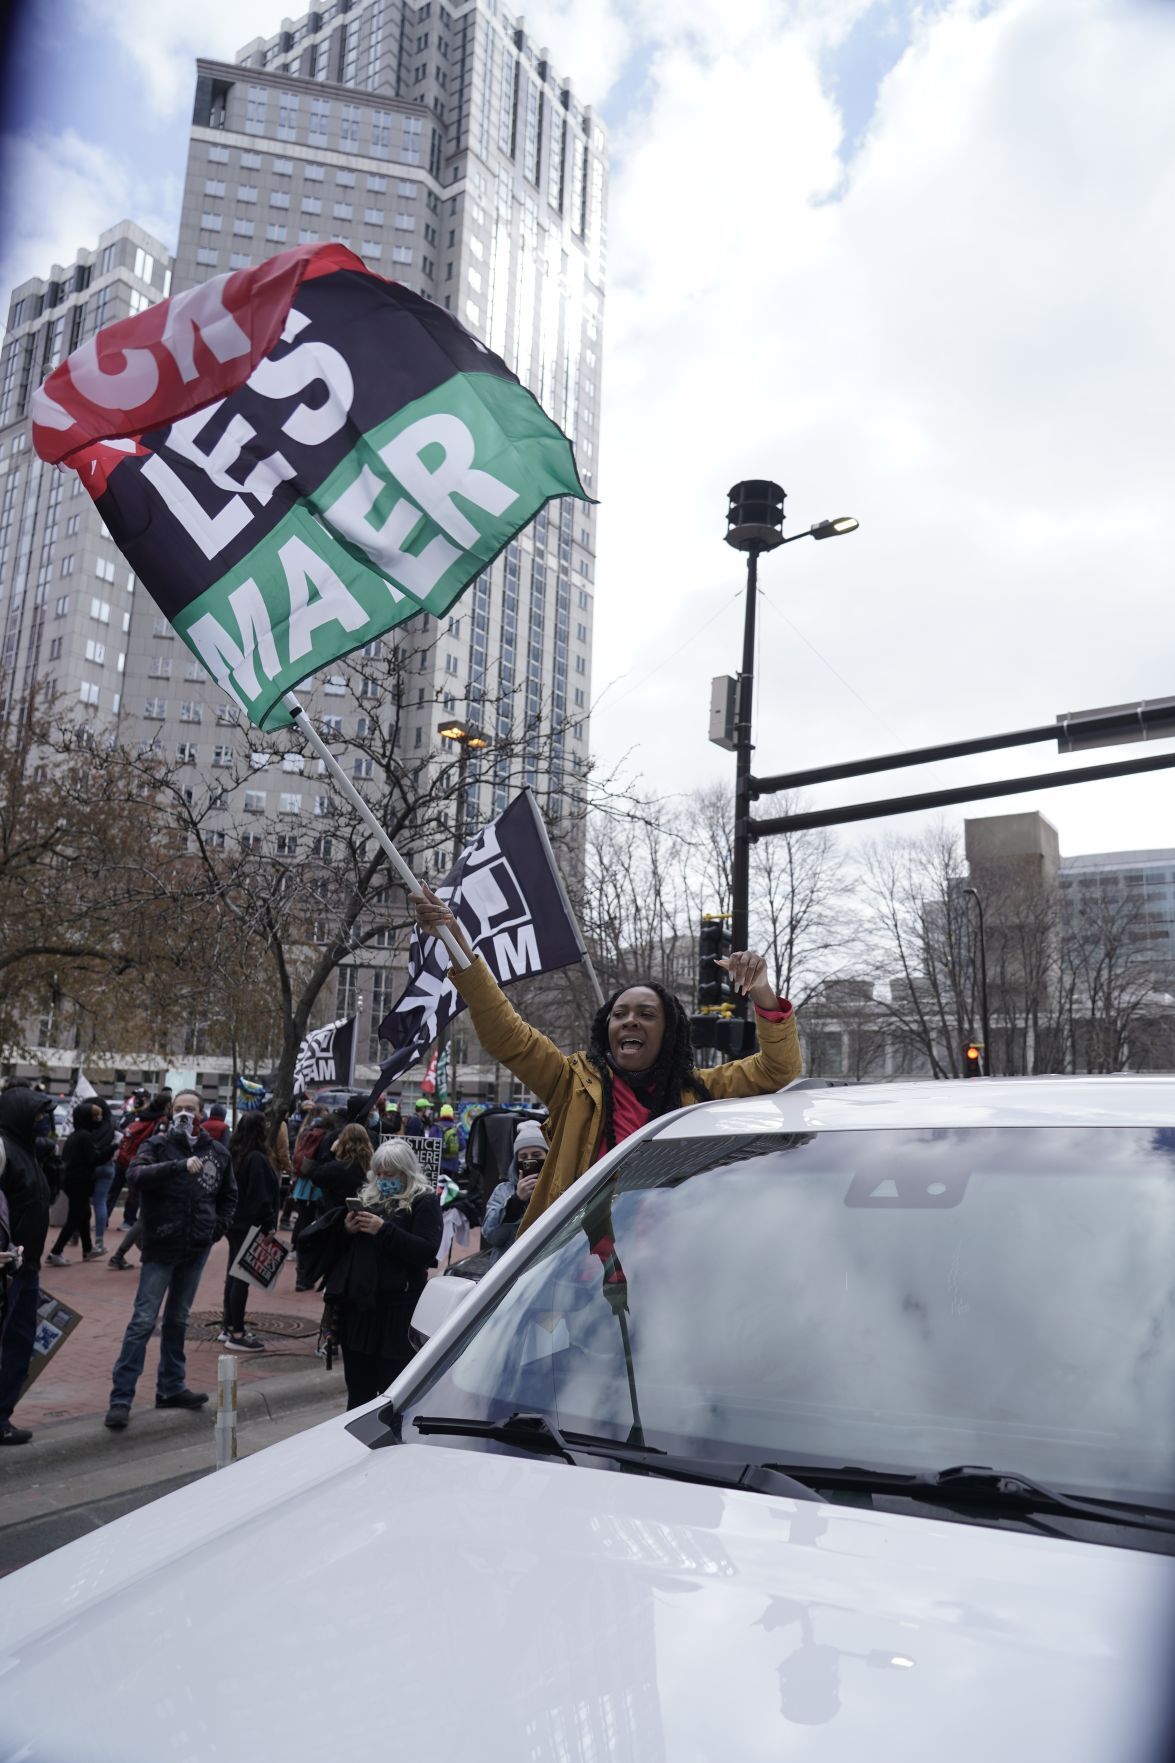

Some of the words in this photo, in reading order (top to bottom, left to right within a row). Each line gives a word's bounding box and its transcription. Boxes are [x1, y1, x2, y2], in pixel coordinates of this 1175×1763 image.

[140, 308, 354, 560] LES
[186, 413, 520, 714] MAER
[243, 1252, 272, 1280] MATTER
[248, 1242, 278, 1273] LIVES
